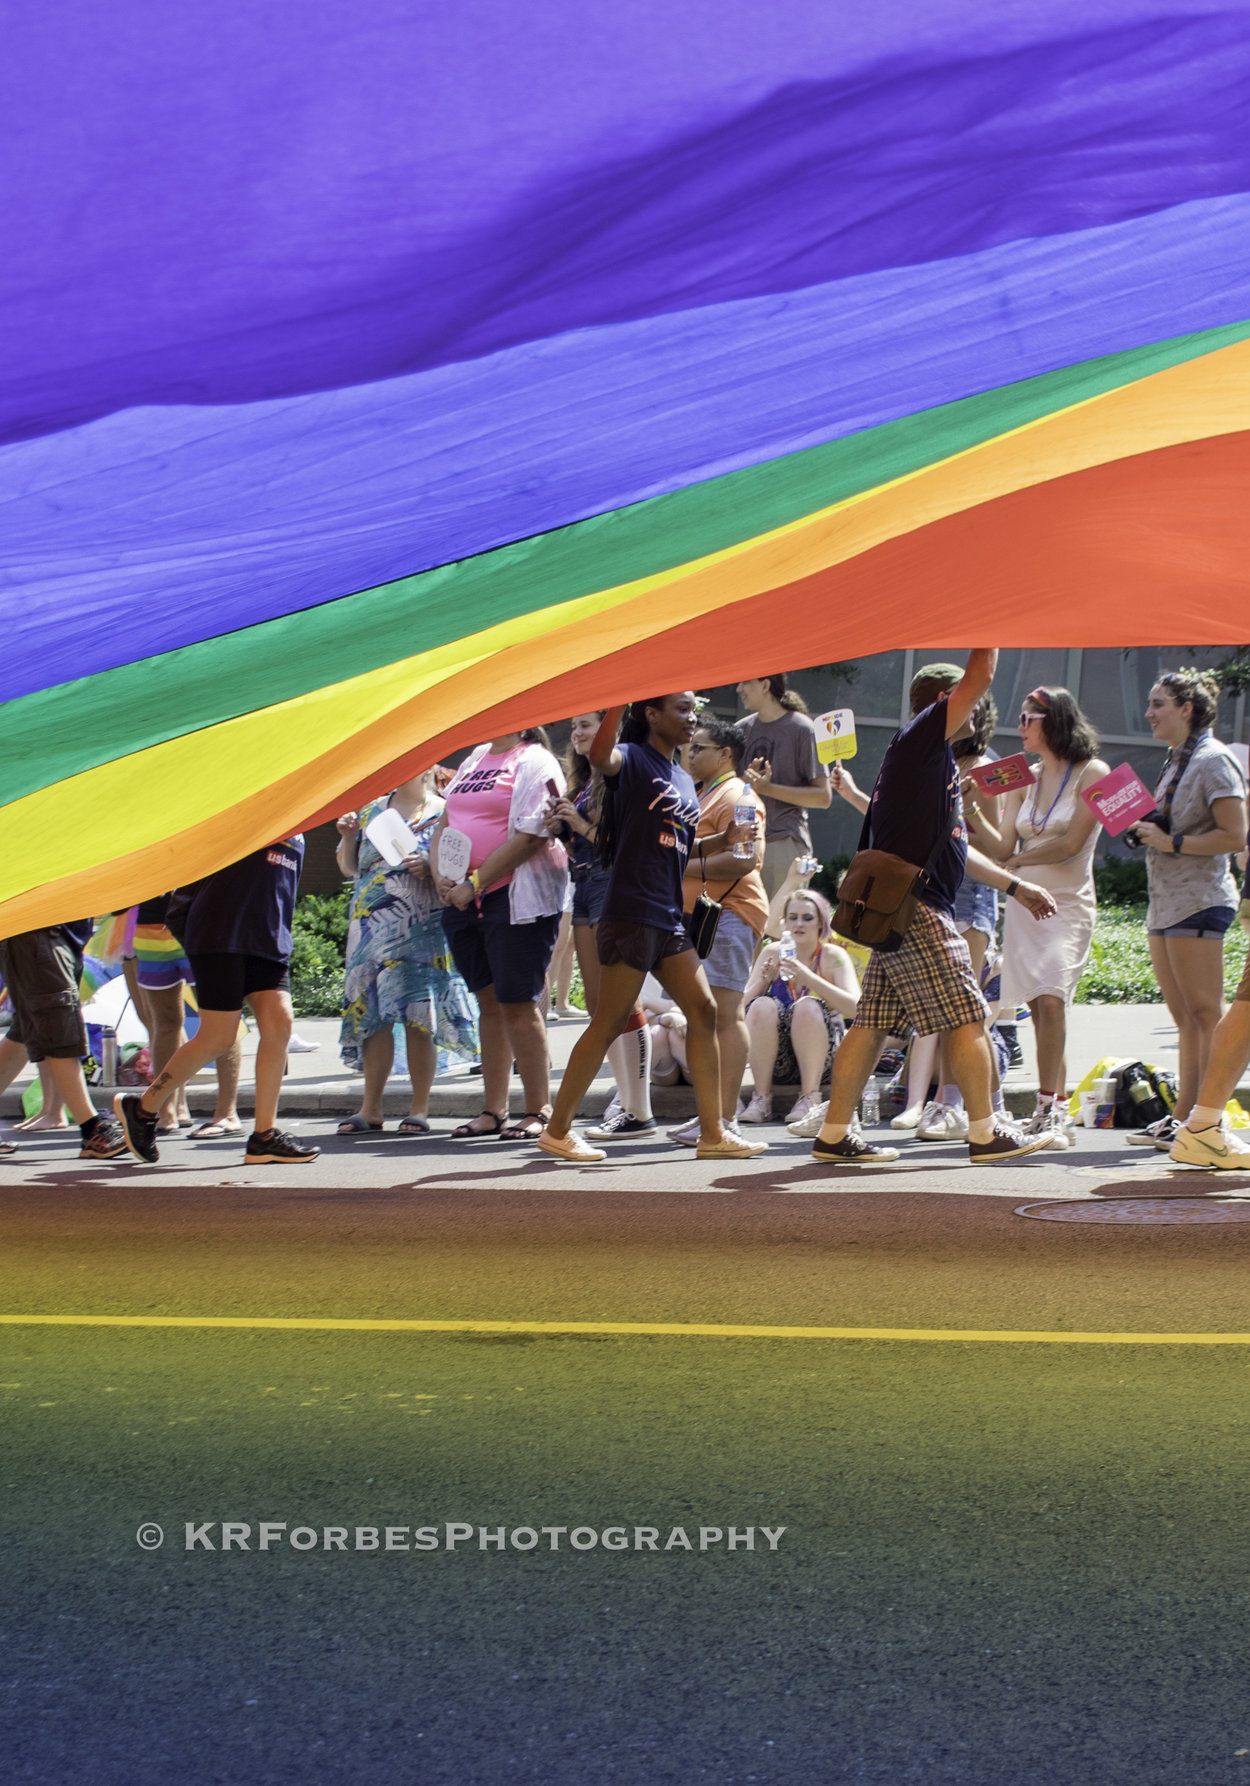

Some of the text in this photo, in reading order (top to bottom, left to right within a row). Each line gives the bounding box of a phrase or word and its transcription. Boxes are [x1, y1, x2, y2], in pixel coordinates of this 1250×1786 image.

[450, 779, 497, 794] HUGS
[1102, 785, 1142, 817] EQUALITY
[443, 834, 462, 852] FREE
